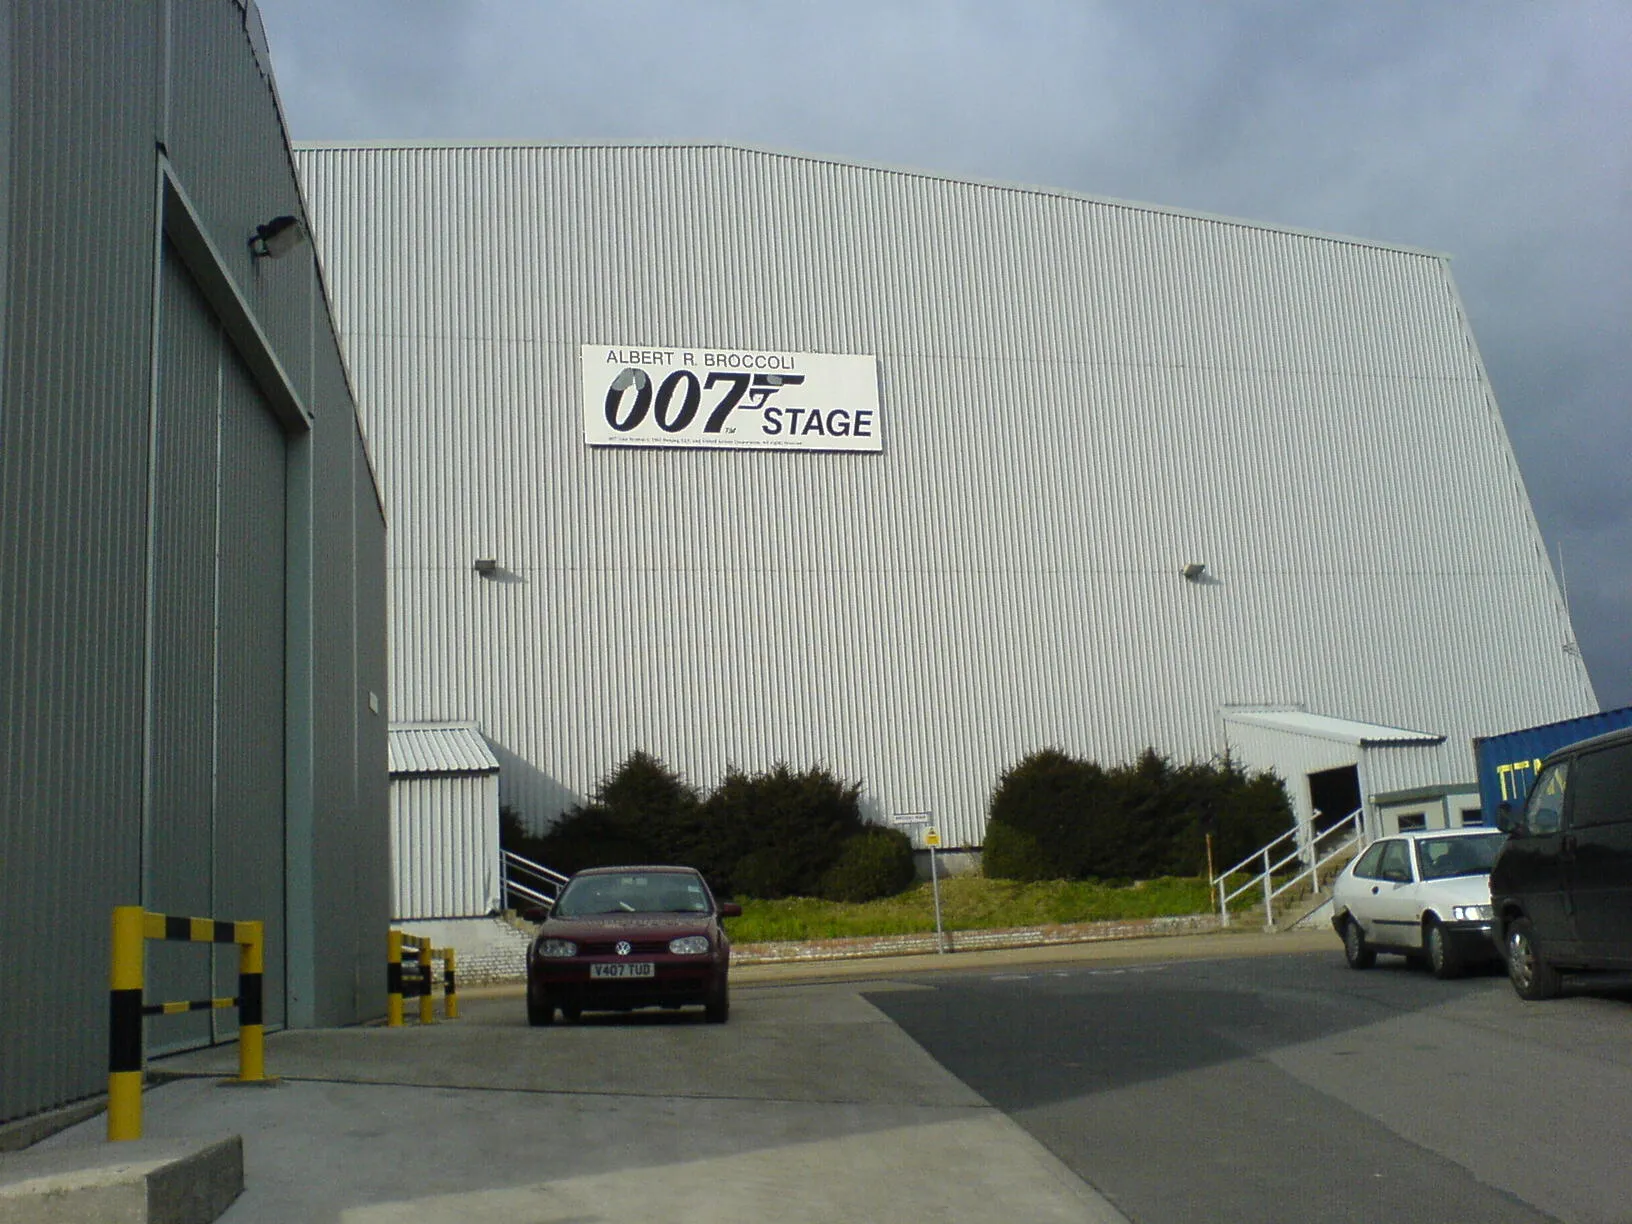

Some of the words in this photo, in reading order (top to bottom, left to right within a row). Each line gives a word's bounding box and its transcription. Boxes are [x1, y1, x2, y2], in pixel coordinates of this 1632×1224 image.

[606, 350, 675, 365] ALBERT
[704, 353, 795, 370] BROCCOLI
[605, 367, 751, 433] 007
[762, 407, 873, 437] STAGE
